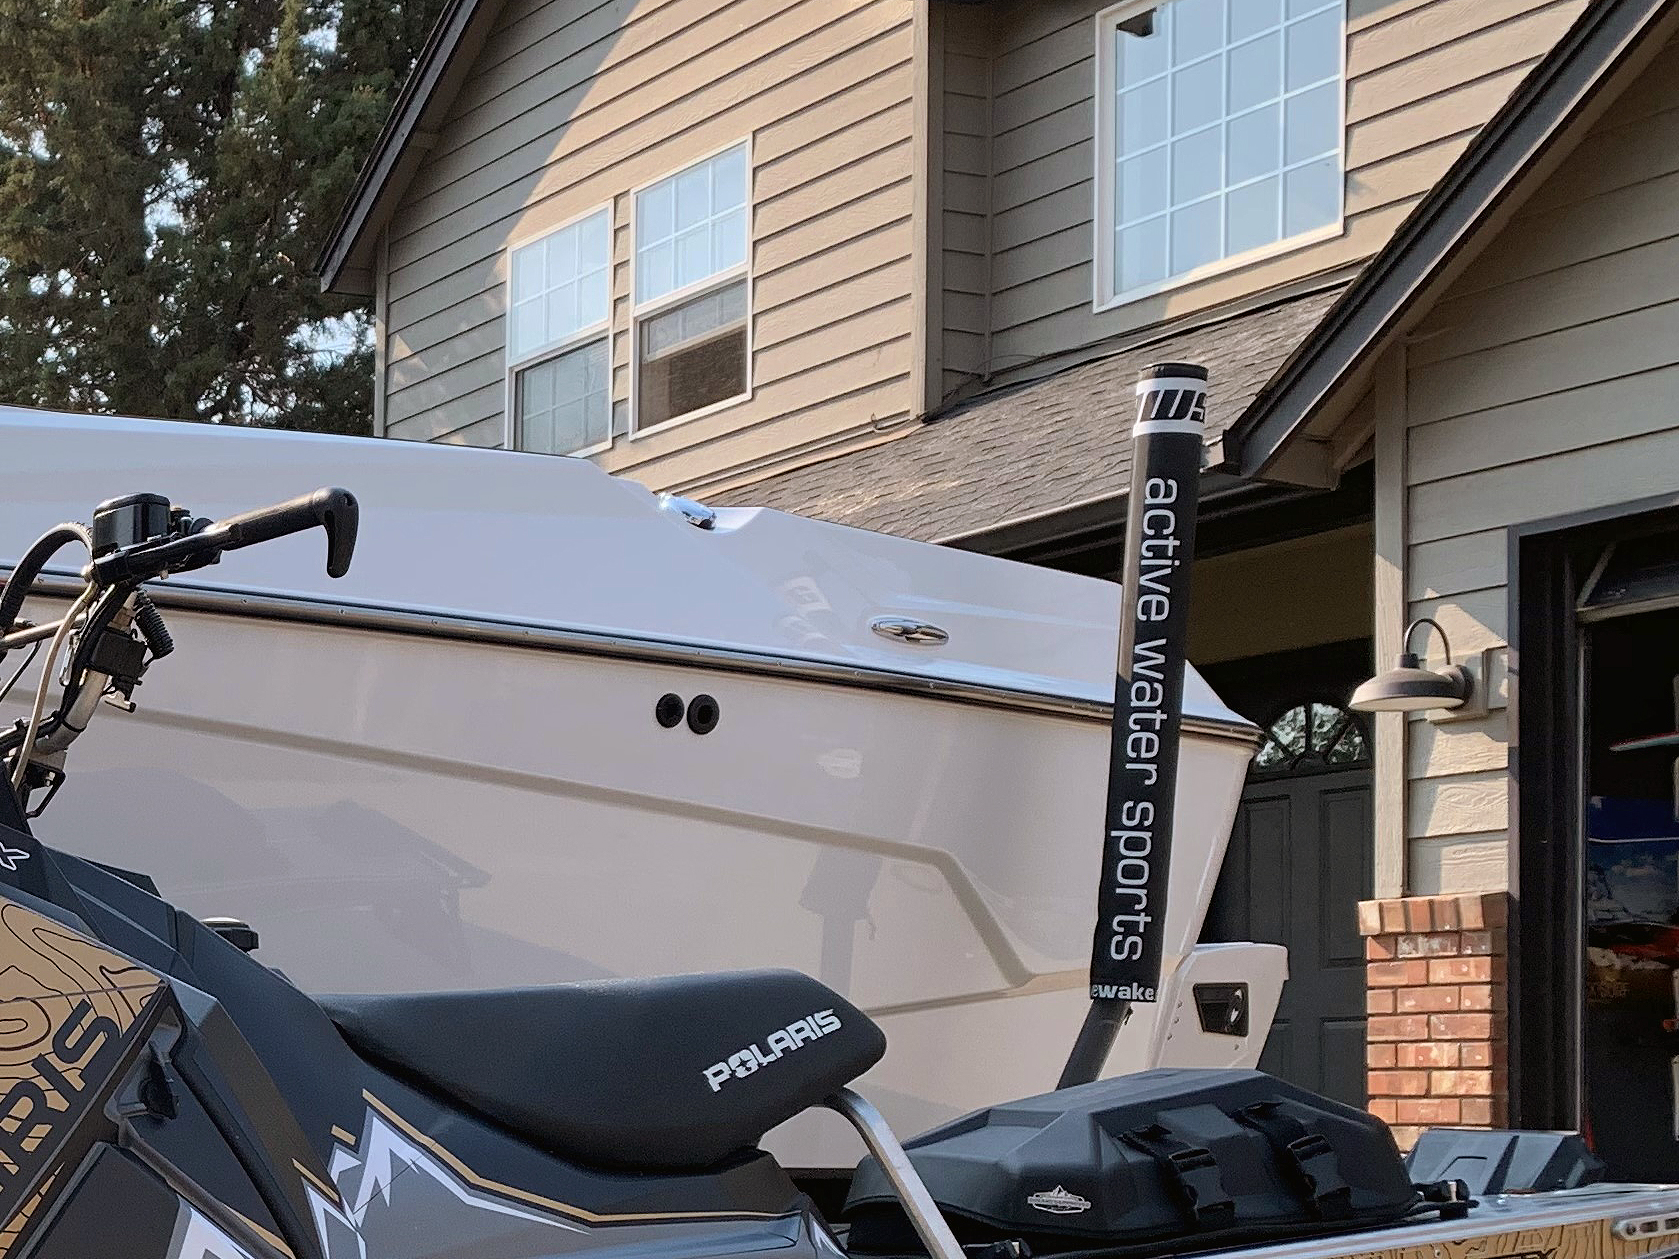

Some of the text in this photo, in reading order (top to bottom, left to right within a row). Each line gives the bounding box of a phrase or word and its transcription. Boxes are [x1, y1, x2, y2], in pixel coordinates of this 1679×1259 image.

[1136, 477, 1181, 622] active
[1125, 638, 1168, 786] water
[1110, 800, 1155, 961] sports
[702, 1008, 843, 1093] POLARIS
